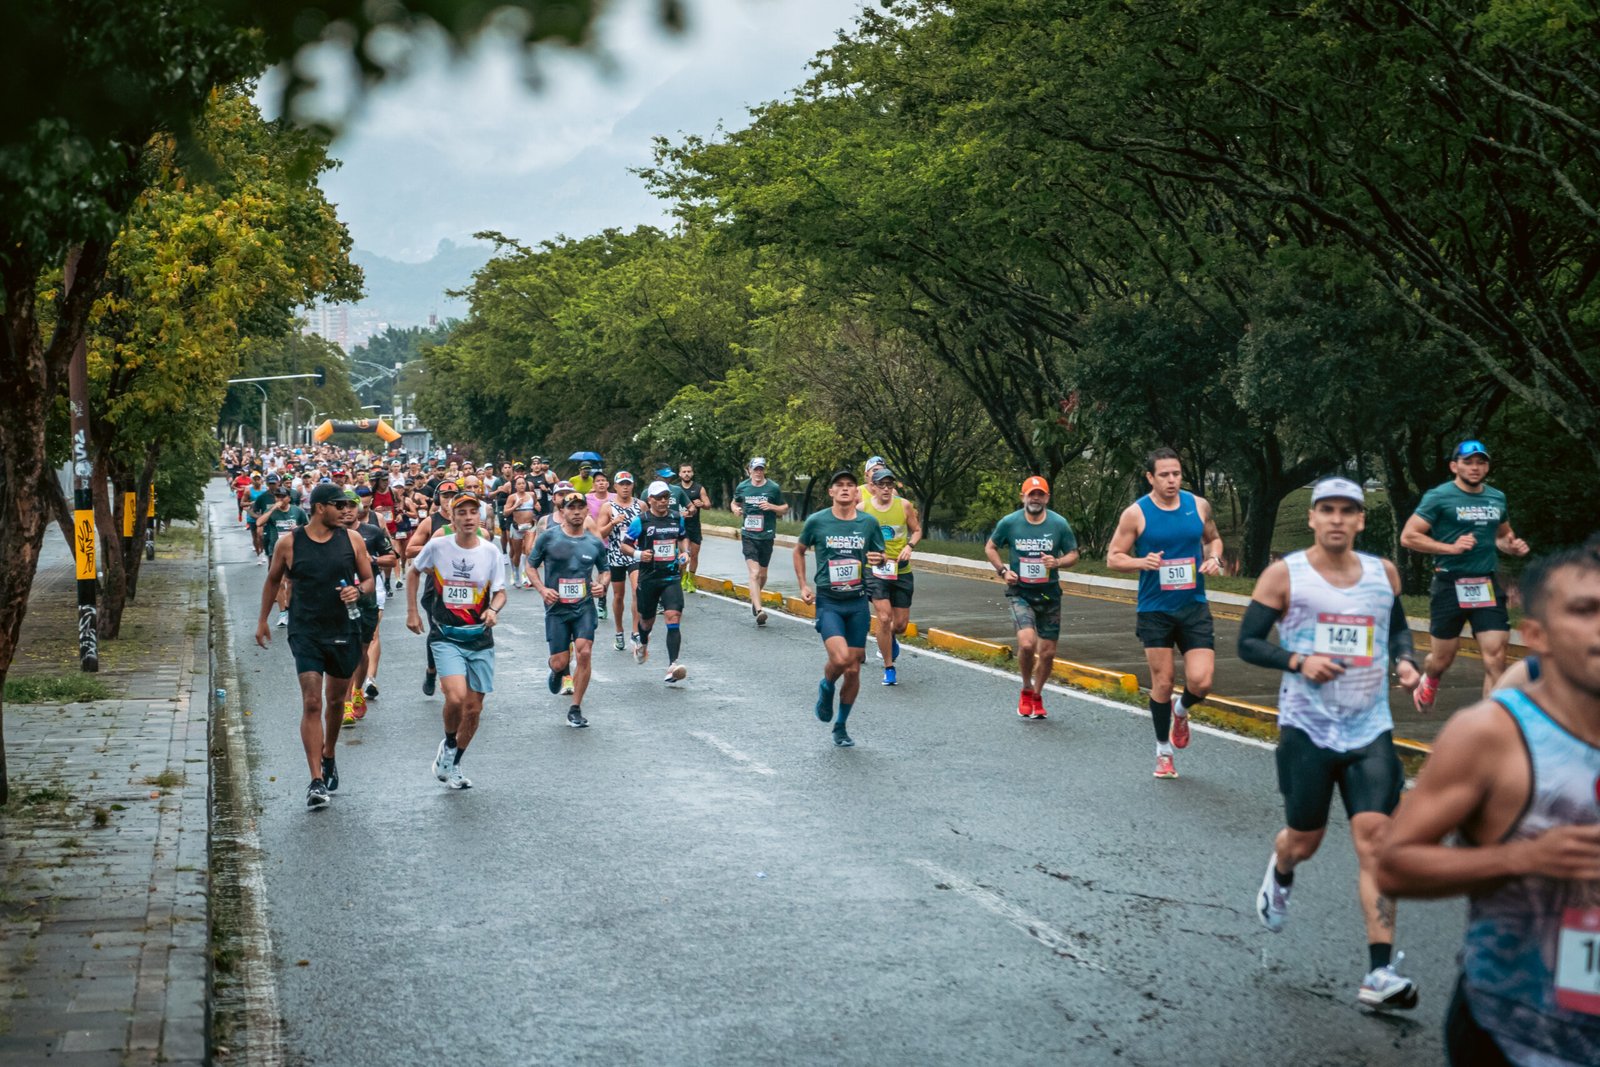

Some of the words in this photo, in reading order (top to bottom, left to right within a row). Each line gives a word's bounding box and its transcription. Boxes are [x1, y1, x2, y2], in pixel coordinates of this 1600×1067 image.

[836, 566, 853, 576] 1387
[1027, 565, 1040, 574] 198
[1169, 567, 1185, 579] 510
[448, 588, 468, 599] 2418
[563, 585, 579, 594] 1183
[1328, 627, 1358, 645] 1474
